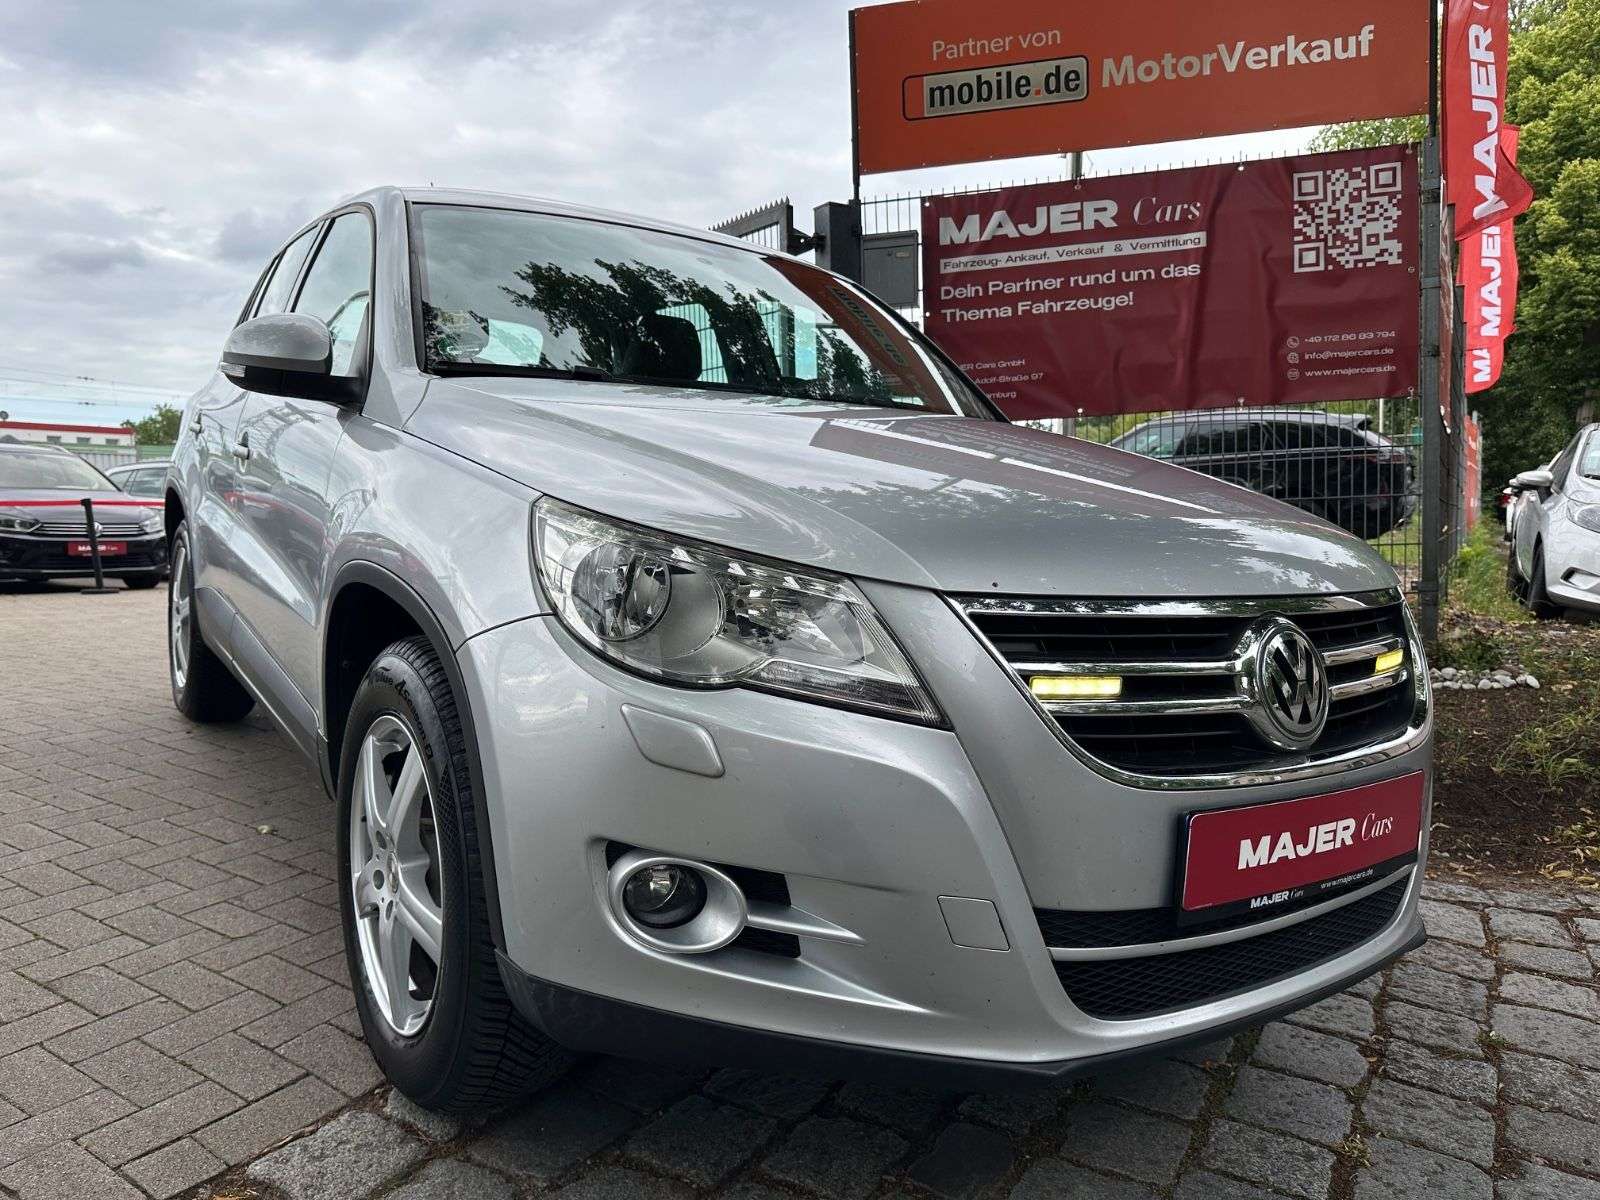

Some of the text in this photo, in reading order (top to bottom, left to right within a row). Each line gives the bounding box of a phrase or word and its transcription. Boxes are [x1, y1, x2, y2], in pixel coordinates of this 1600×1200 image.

[931, 29, 1062, 61] Partner von
[1102, 24, 1375, 88] MotorVerkauf
[928, 64, 1081, 108] mobile.de
[1468, 23, 1509, 220] MAJER
[939, 196, 1201, 246] MAJER Cars
[1055, 245, 1105, 258] Verkauf
[1113, 243, 1123, 252] &
[1129, 236, 1201, 251] Vermittlung
[940, 263, 1202, 300] Dein Partner rund um das
[941, 292, 1134, 323] Thema Fahrzeuge!
[997, 359, 1026, 368] GmbH
[1304, 347, 1394, 360] info@majercars.de
[1304, 364, 1396, 377] www.majercars.de
[1237, 810, 1394, 871] MAJER Cars
[1250, 890, 1290, 909] MAJER
